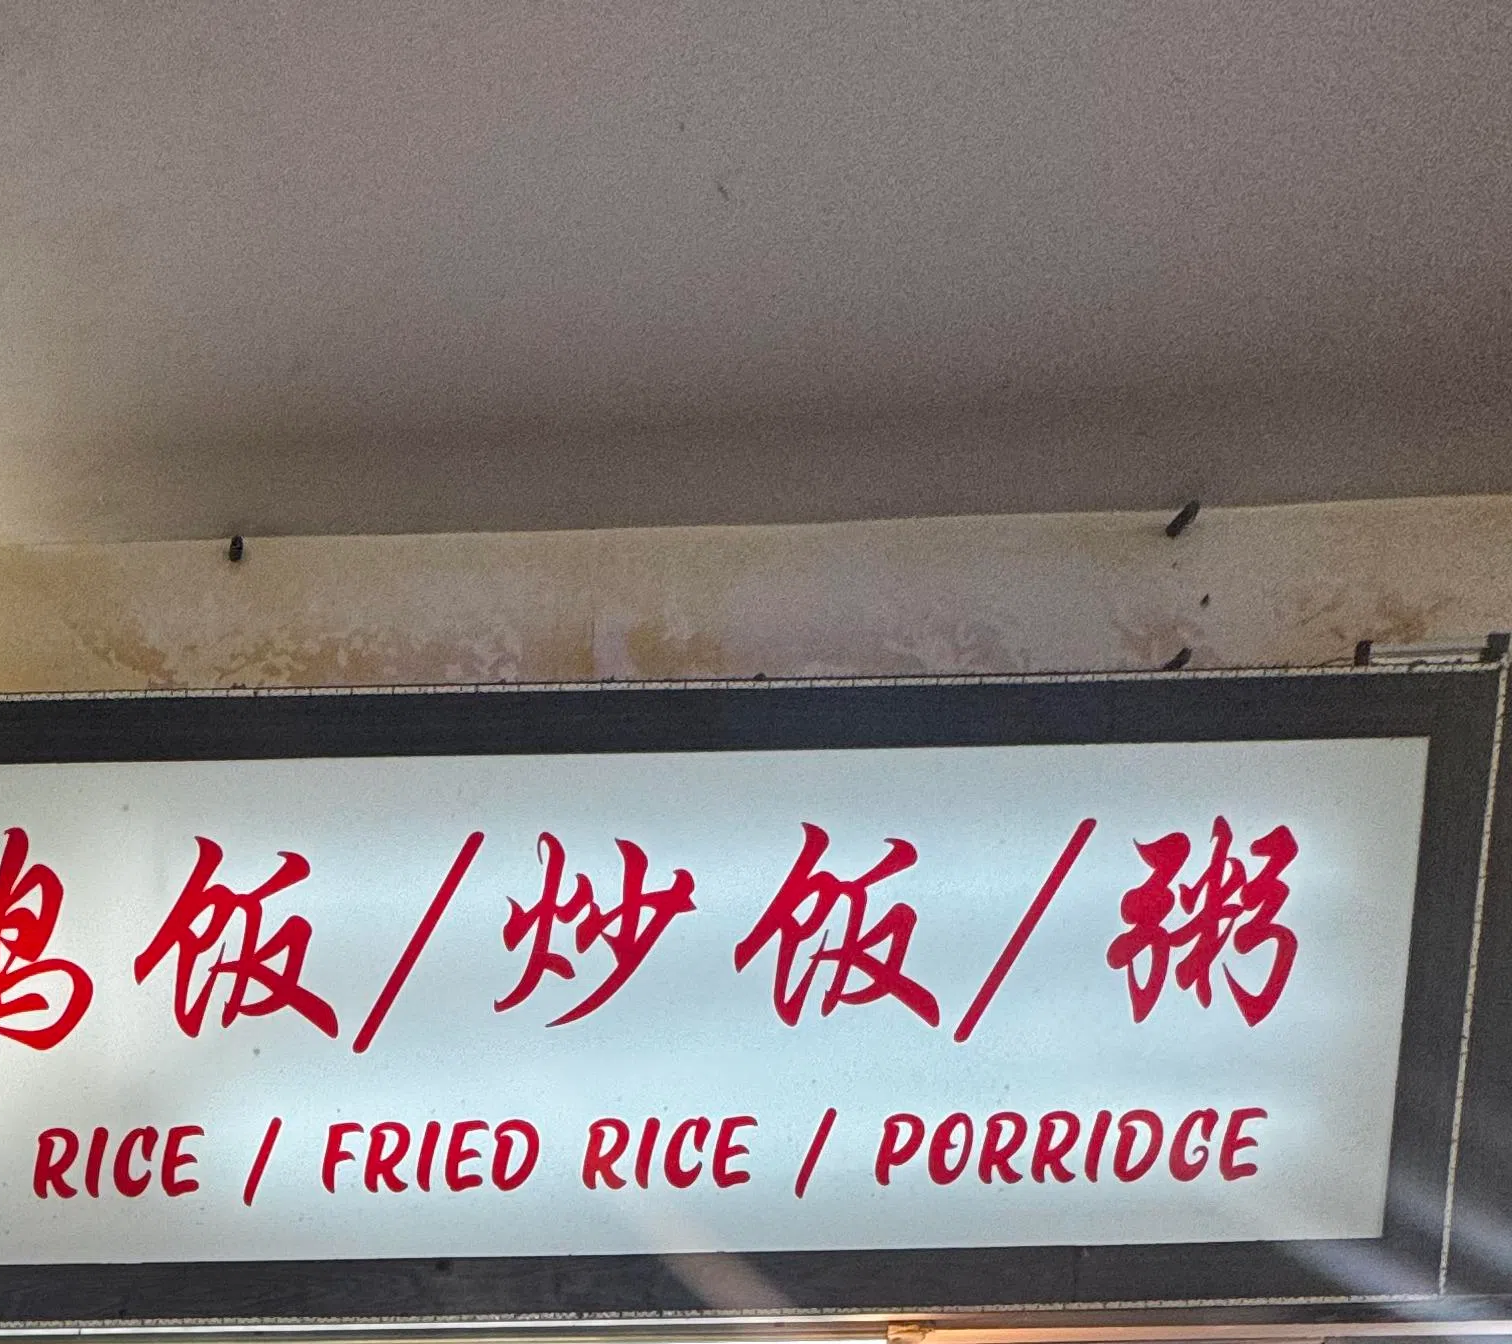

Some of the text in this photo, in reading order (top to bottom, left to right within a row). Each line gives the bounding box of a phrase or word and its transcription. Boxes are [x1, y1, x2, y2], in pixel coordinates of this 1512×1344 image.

[34, 1124, 205, 1201] RICE
[320, 1117, 540, 1194] FRIED
[582, 1115, 758, 1191] RICE
[873, 1106, 1270, 1189] PORRIDGE
